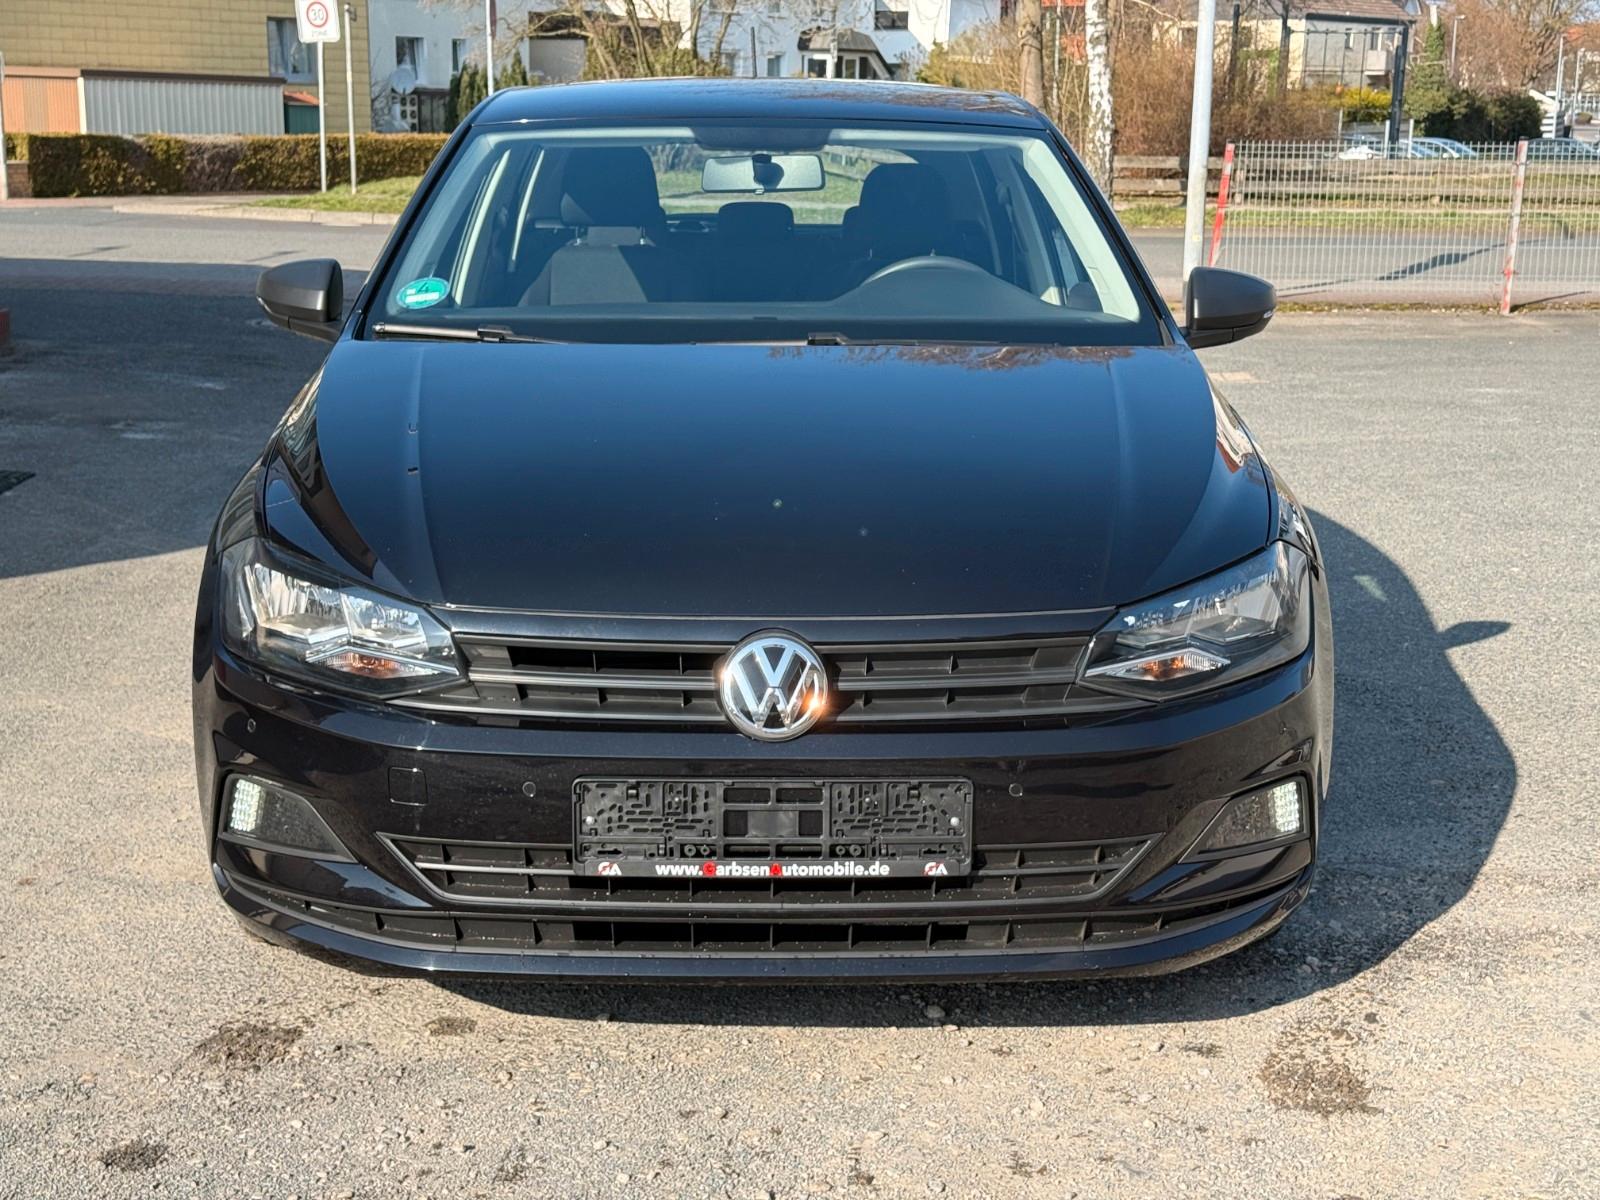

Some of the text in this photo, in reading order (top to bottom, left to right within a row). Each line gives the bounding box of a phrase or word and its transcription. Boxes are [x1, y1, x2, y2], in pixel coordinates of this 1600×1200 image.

[311, 8, 324, 21] 30
[724, 635, 824, 734] VW
[655, 861, 890, 876] www.GarbsenAutomobile.de
